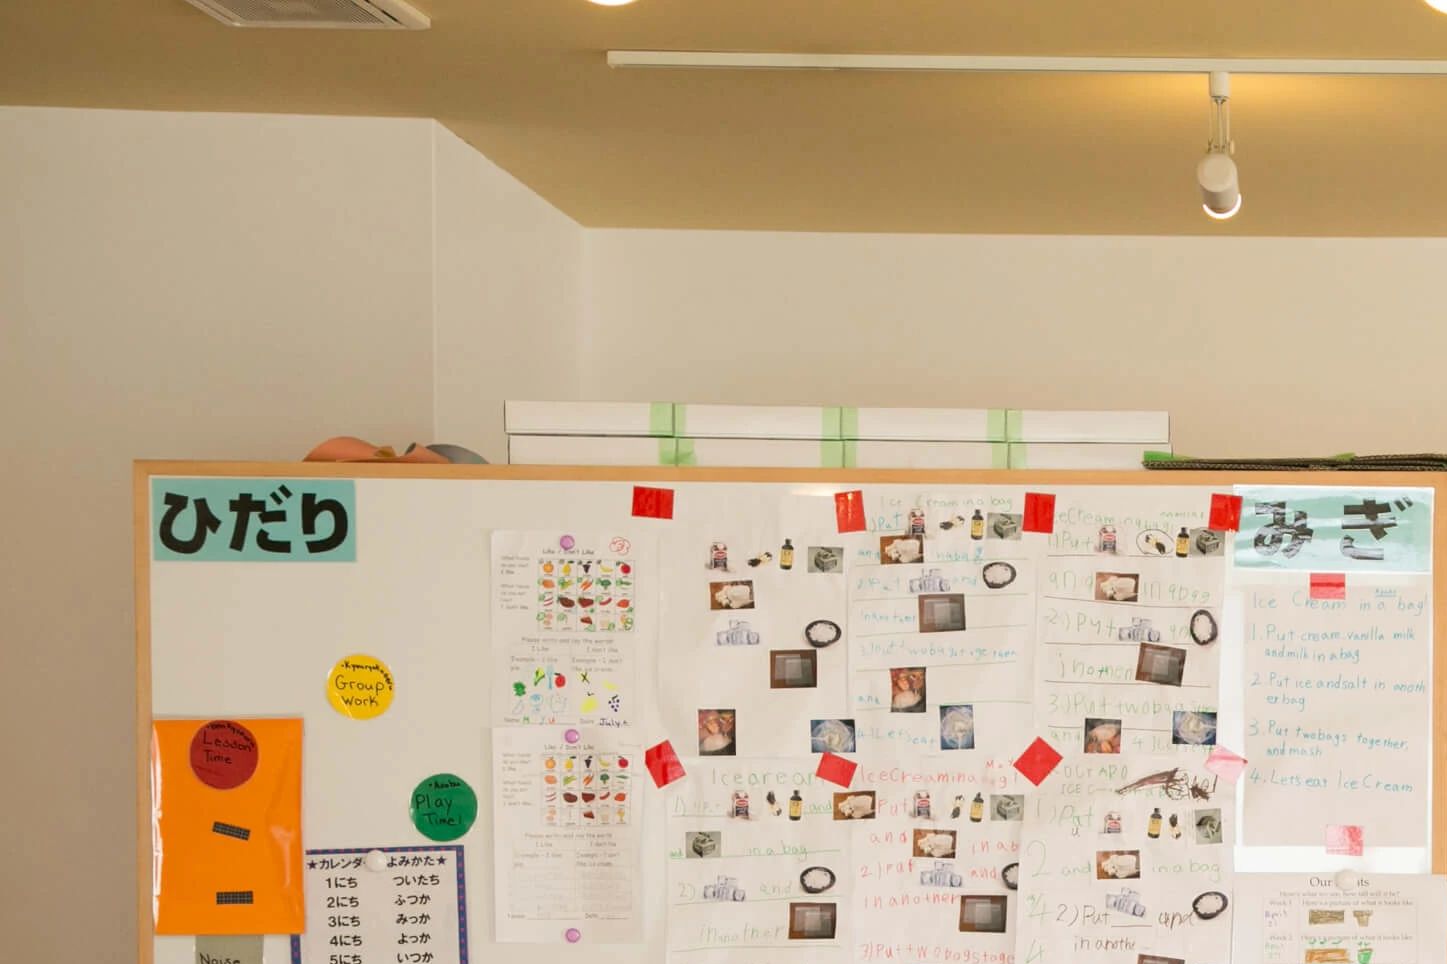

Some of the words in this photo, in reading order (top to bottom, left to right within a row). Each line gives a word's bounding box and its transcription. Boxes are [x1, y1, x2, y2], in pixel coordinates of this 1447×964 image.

[159, 485, 349, 554] ひだり
[1254, 495, 1414, 560] みぎ
[1252, 591, 1279, 610] Ice
[1291, 590, 1348, 611] Cream
[1266, 623, 1295, 642] Put
[1346, 626, 1386, 641] vanilla
[1392, 628, 1416, 641] milk
[335, 674, 385, 696] Group
[1269, 671, 1290, 689] Put
[1294, 678, 1313, 689] ice
[1267, 719, 1289, 737] Put
[415, 793, 453, 816] Play
[320, 858, 365, 869] カレンダ
[326, 878, 358, 889] 1にち
[393, 874, 440, 886] ついたち
[326, 896, 360, 909] 2にち
[394, 893, 431, 906] ふつか
[328, 915, 361, 928] 3にち
[395, 913, 431, 925] みっか
[329, 935, 363, 947] 4にち
[397, 932, 431, 945] よっか
[397, 952, 434, 964] いつか
